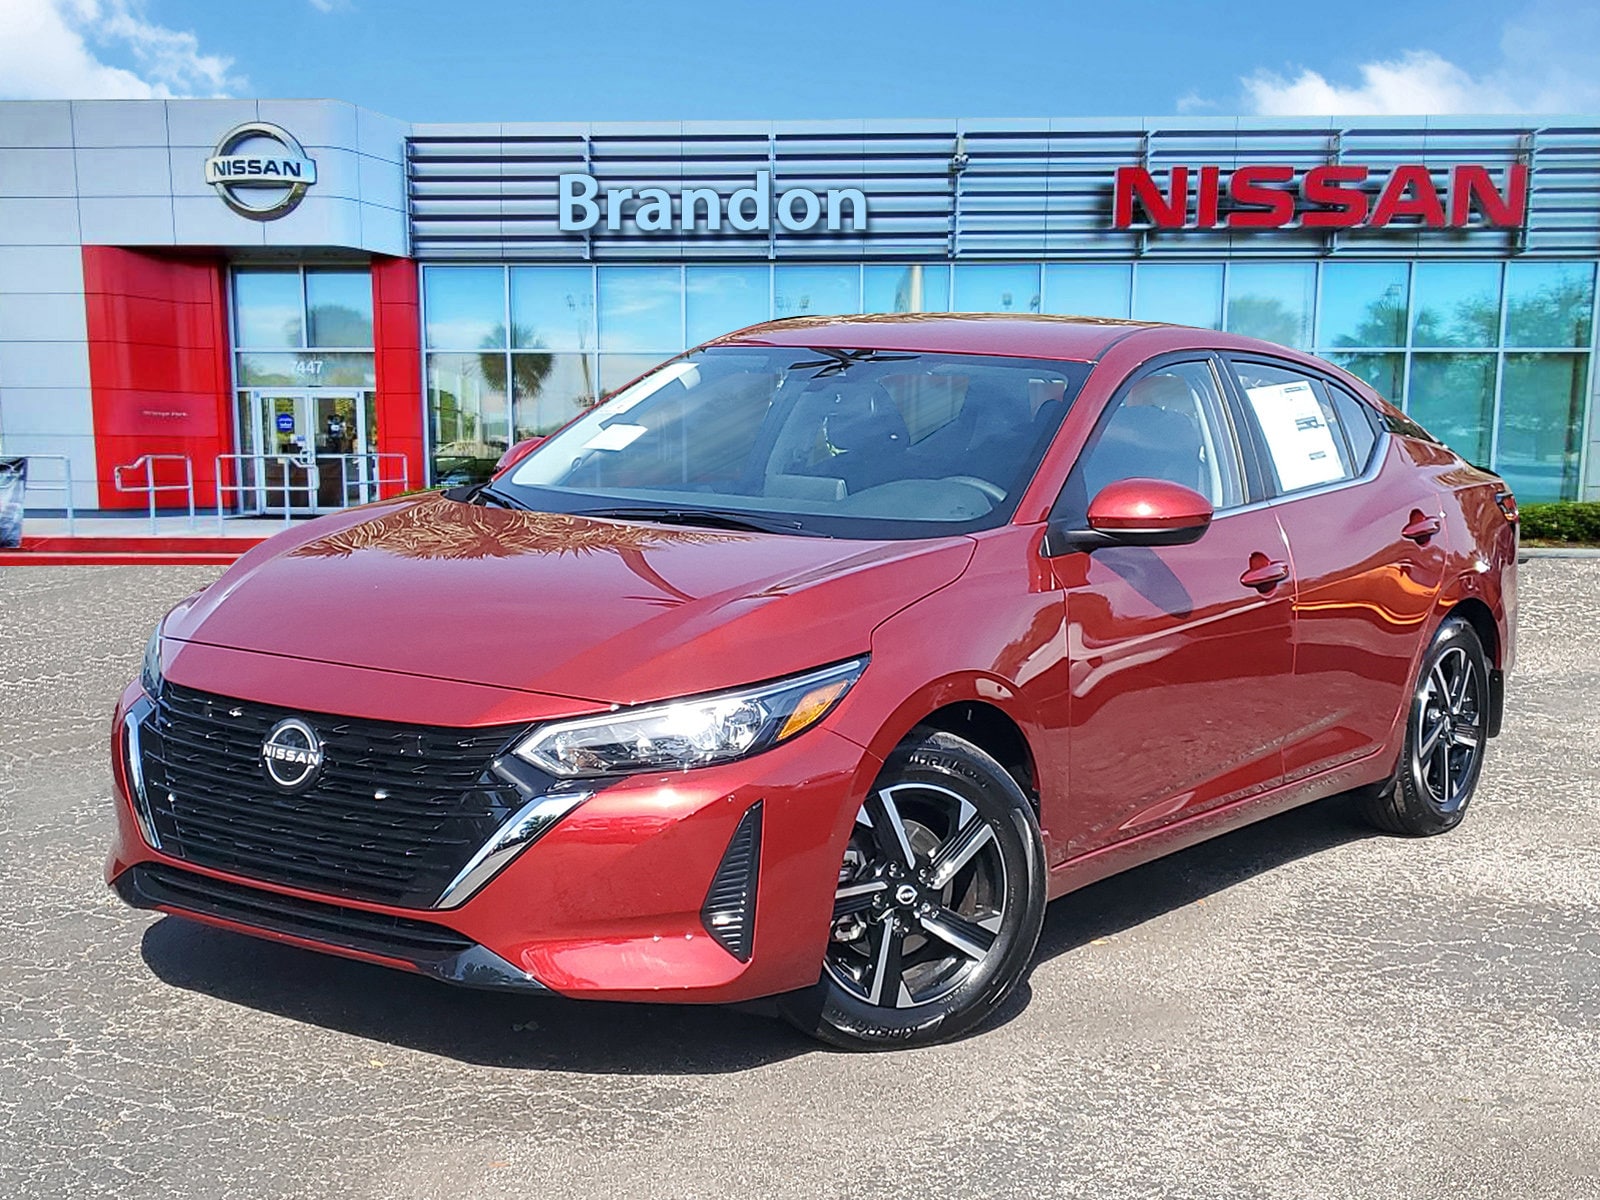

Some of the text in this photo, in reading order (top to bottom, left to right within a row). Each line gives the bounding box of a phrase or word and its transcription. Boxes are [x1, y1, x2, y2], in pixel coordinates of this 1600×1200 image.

[213, 159, 301, 177] NISSAN
[559, 170, 867, 232] Brandon
[1113, 164, 1528, 229] NISSAN
[262, 743, 320, 765] NISSAN
